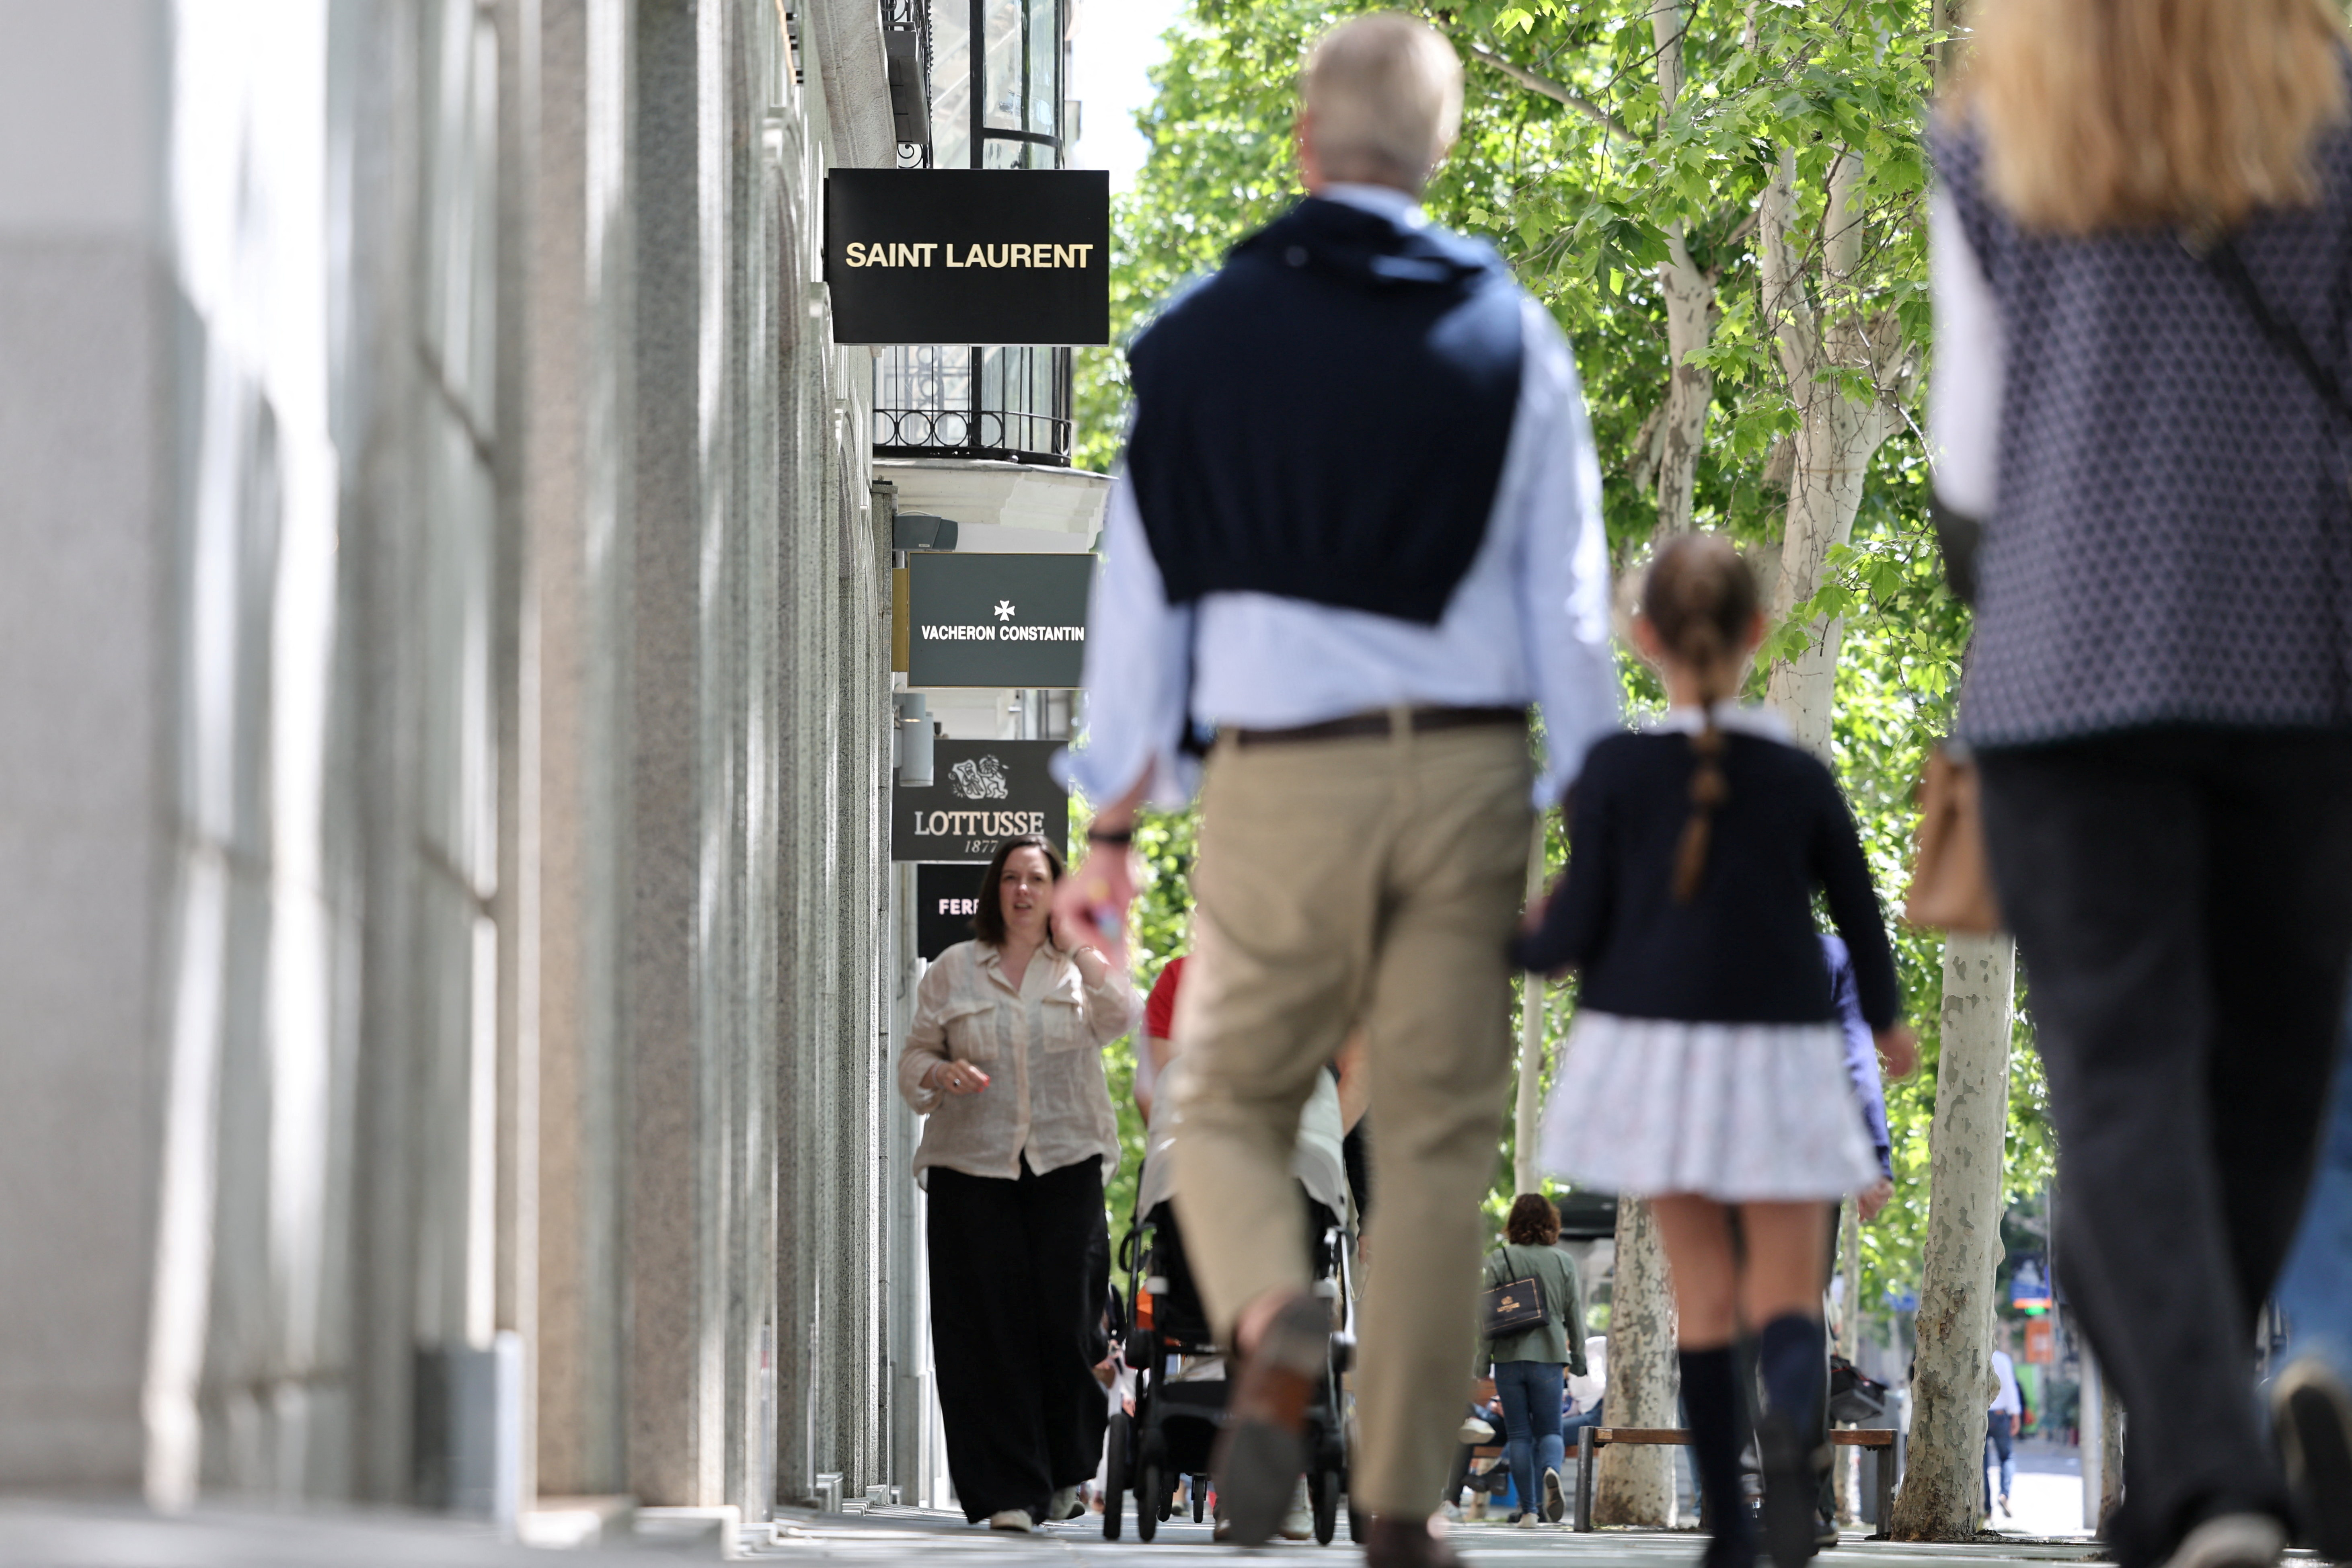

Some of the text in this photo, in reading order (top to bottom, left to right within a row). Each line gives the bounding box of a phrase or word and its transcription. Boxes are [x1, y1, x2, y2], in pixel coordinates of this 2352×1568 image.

[846, 242, 1093, 268] SAINT LAURENT
[922, 625, 1085, 641] VACHERON CONSTANTIN
[914, 811, 1045, 837] LOTTUSSE
[965, 839, 998, 853] 1877
